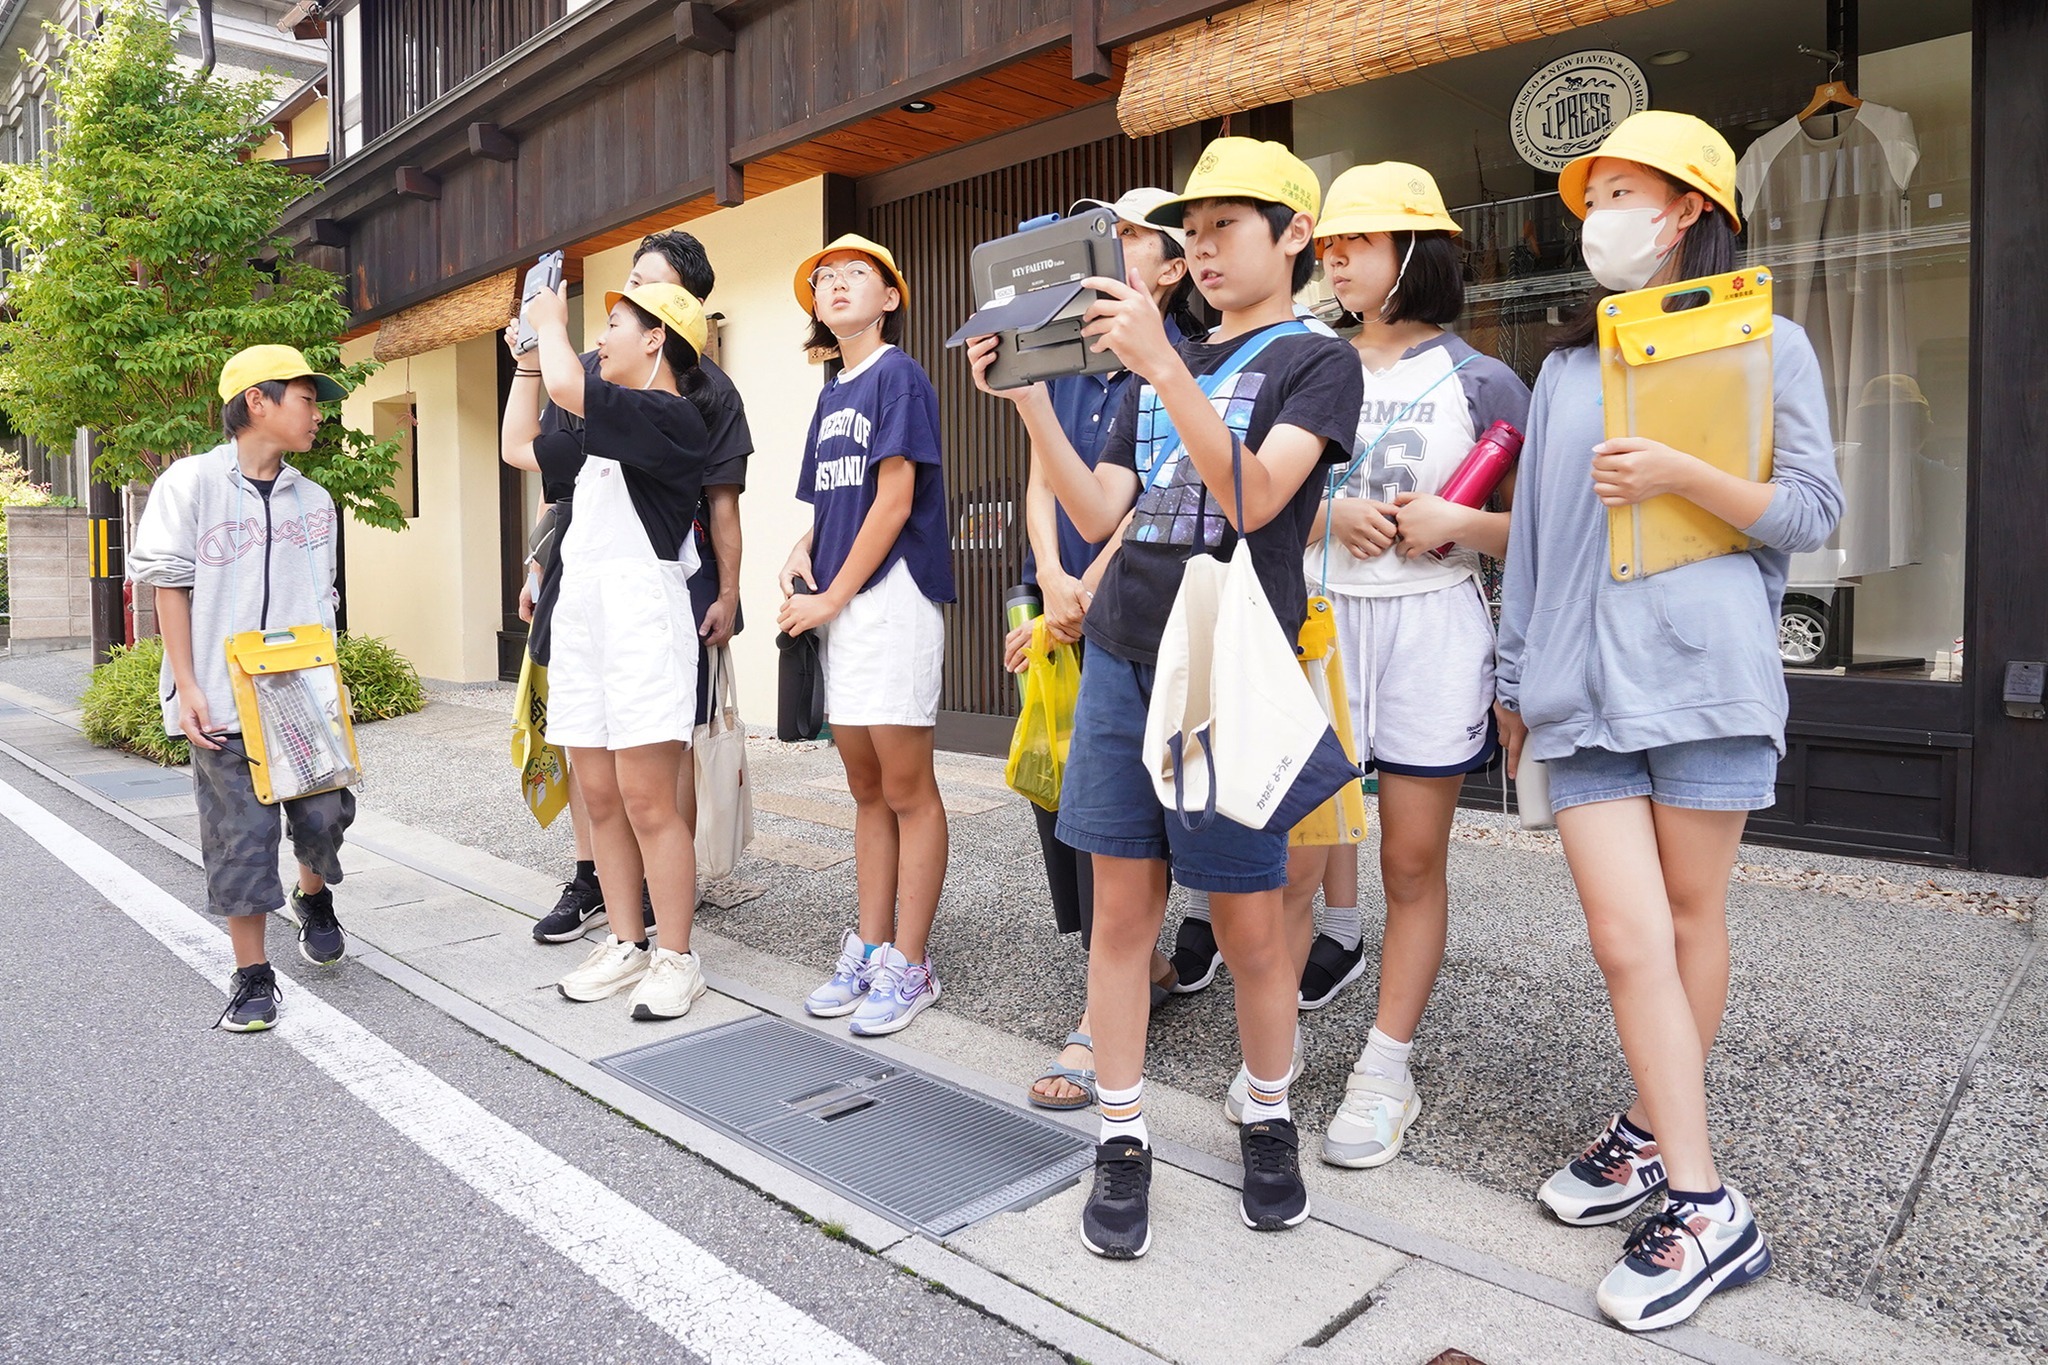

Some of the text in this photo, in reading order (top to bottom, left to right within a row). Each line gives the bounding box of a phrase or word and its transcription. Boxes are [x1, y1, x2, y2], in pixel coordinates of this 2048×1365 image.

[1548, 55, 1616, 76] NEW HAVEN
[1623, 67, 1644, 114] CAMBRI
[1515, 80, 1543, 164] SAN FRANCISCO
[1541, 92, 1611, 140] J.PRESS
[1551, 160, 1571, 169] NE
[854, 412, 871, 448] OF
